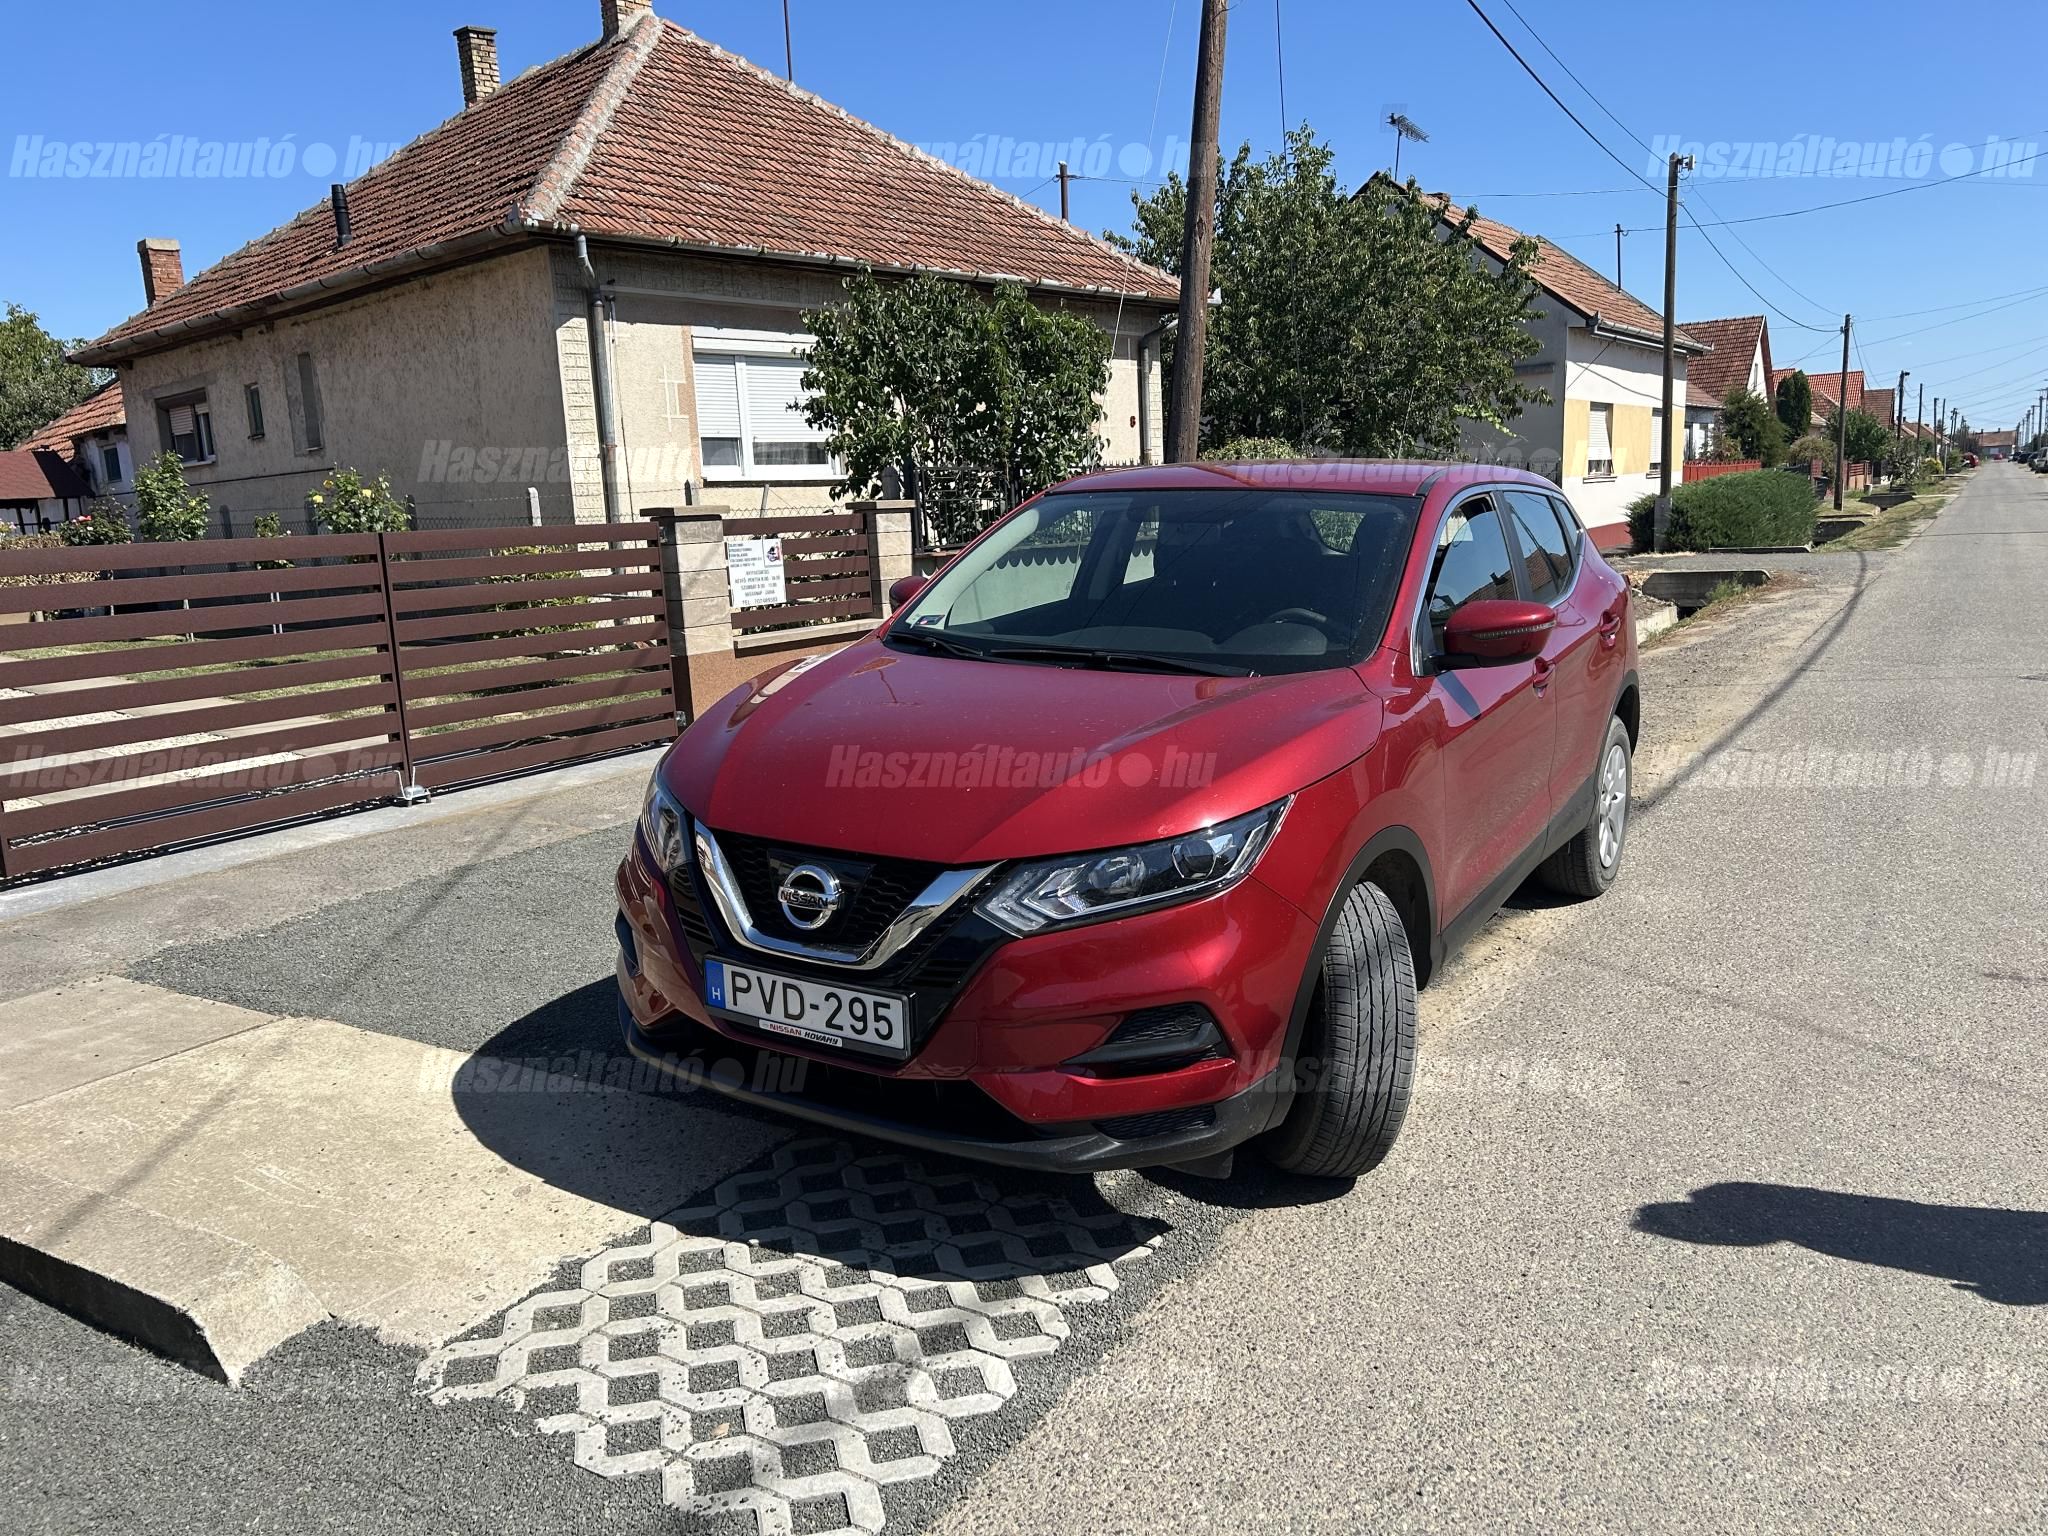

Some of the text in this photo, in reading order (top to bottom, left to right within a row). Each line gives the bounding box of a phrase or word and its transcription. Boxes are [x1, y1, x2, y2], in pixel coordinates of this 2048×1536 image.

[781, 890, 829, 908] NISSAN
[712, 970, 894, 1041] H PVD-295
[769, 1023, 802, 1037] NISSAN
